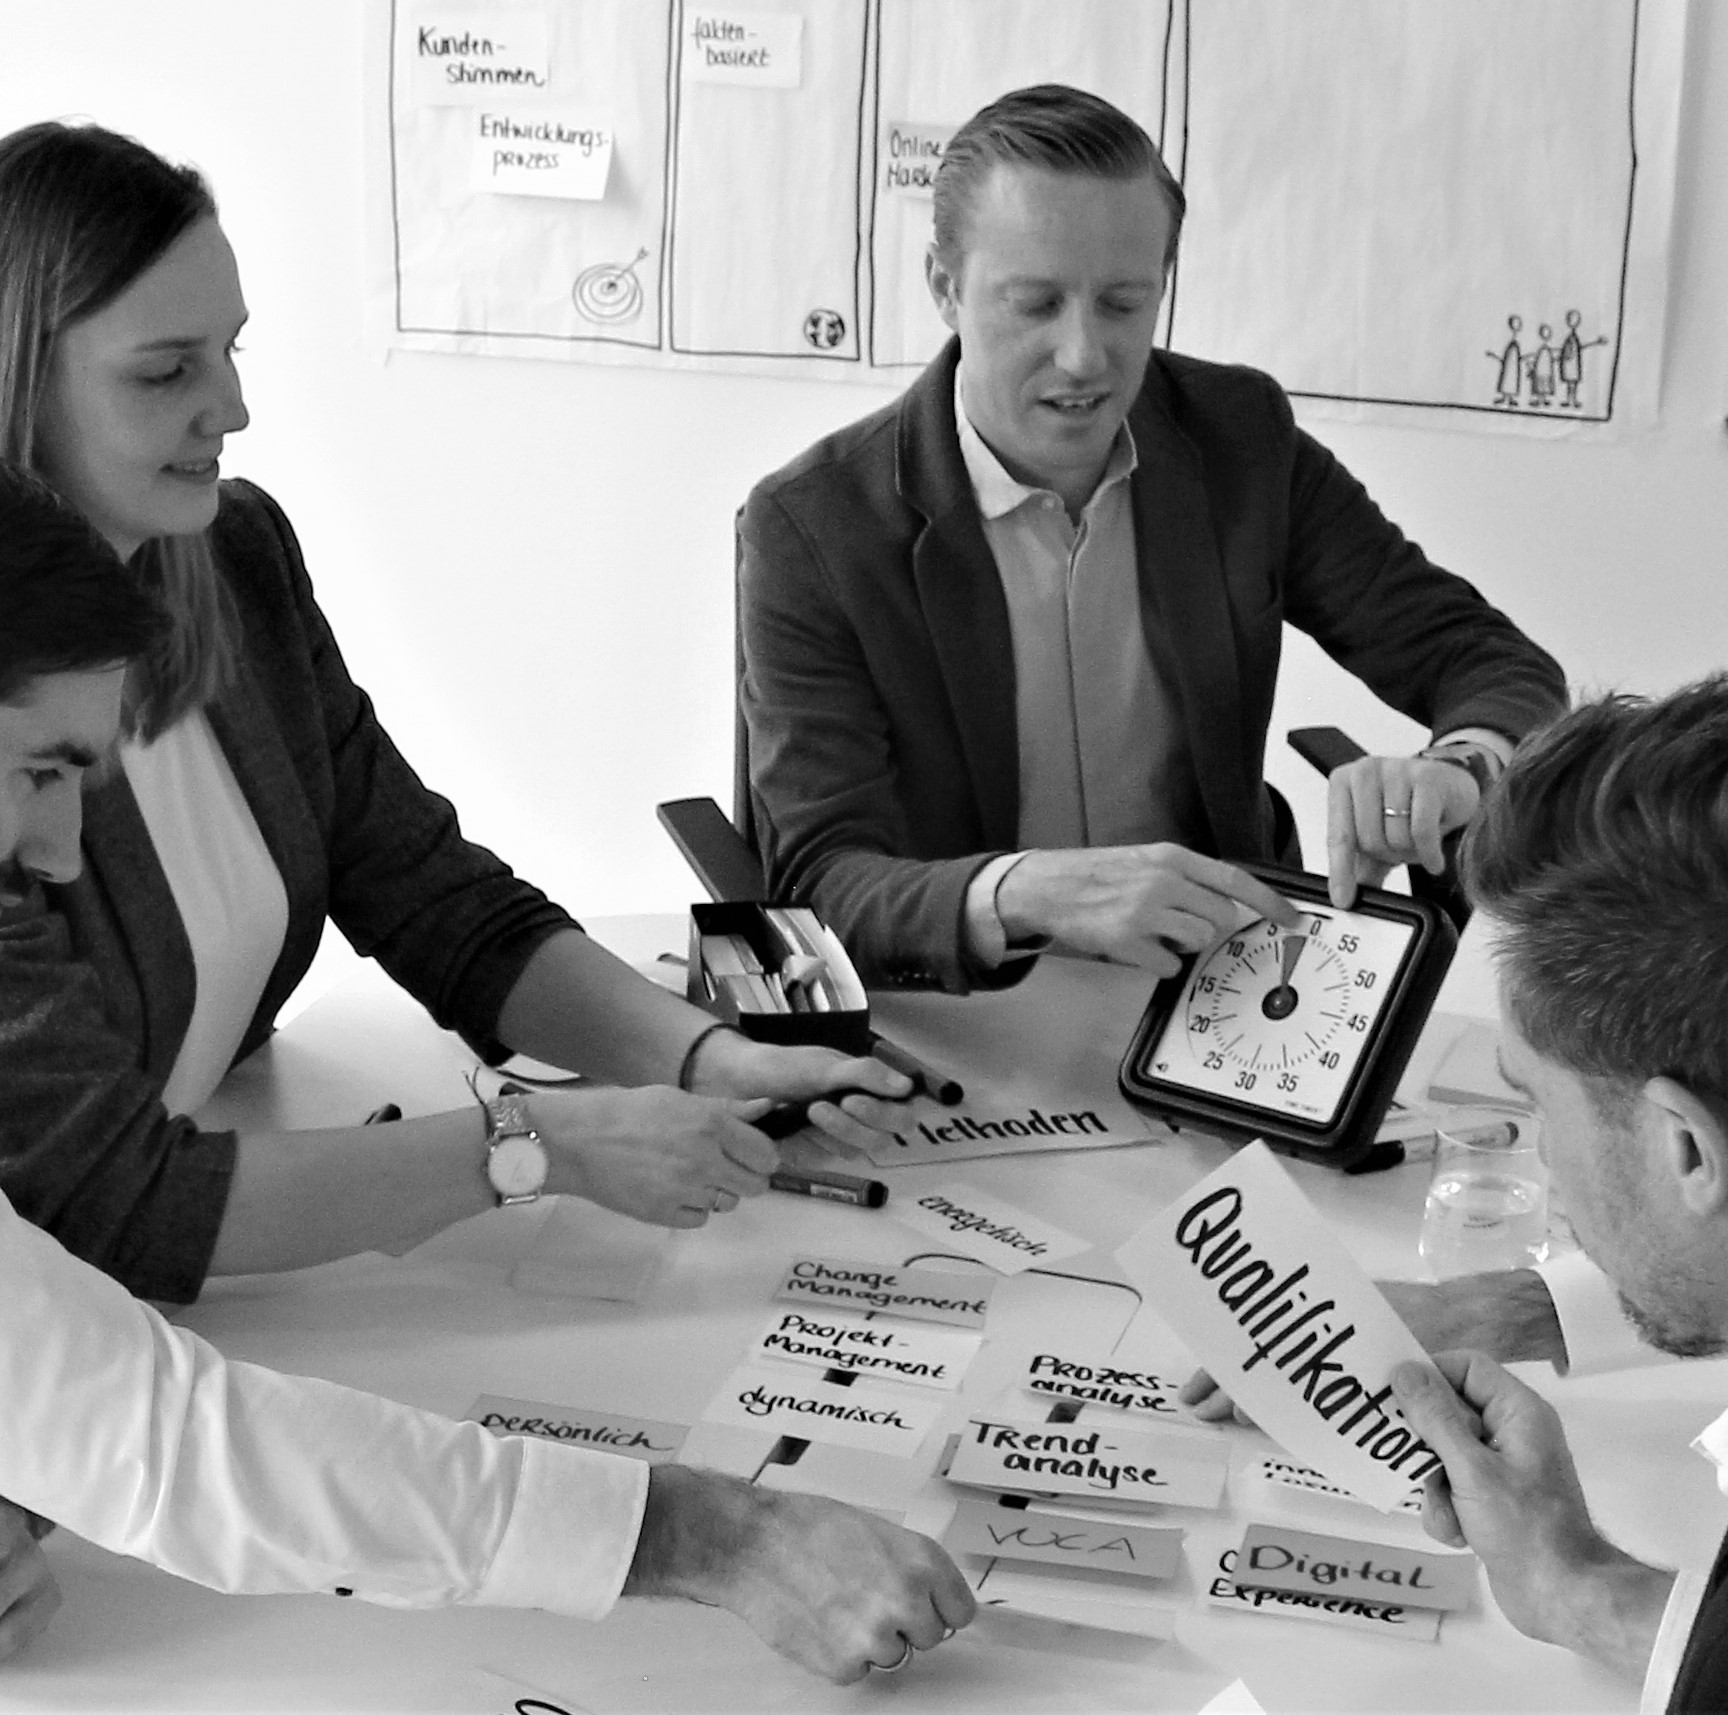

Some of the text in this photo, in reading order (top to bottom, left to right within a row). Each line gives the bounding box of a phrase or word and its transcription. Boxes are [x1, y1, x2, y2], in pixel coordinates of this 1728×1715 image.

[418, 25, 507, 56] Kunden-
[480, 112, 610, 158] Entwicklungs-
[1309, 919, 1322, 937] 0
[1225, 940, 1245, 959] 10
[1336, 934, 1361, 954] 55
[1198, 975, 1216, 993] 15
[1354, 969, 1377, 989] 50
[1189, 1014, 1211, 1034] 20
[1346, 1013, 1369, 1034] 45
[1203, 1049, 1225, 1071] 25
[1319, 1049, 1341, 1070] 40
[1234, 1070, 1257, 1092] 30
[1276, 1072, 1299, 1093] 35
[793, 1261, 898, 1290] Change
[787, 1279, 987, 1316] Management
[1175, 1186, 1445, 1483] Qualifikation
[763, 1333, 947, 1379] Management
[1030, 1379, 1177, 1412] analyse
[738, 1384, 915, 1430] dynamisch
[1003, 1453, 1169, 1489] analyse
[1248, 1545, 1435, 1589] Digital
